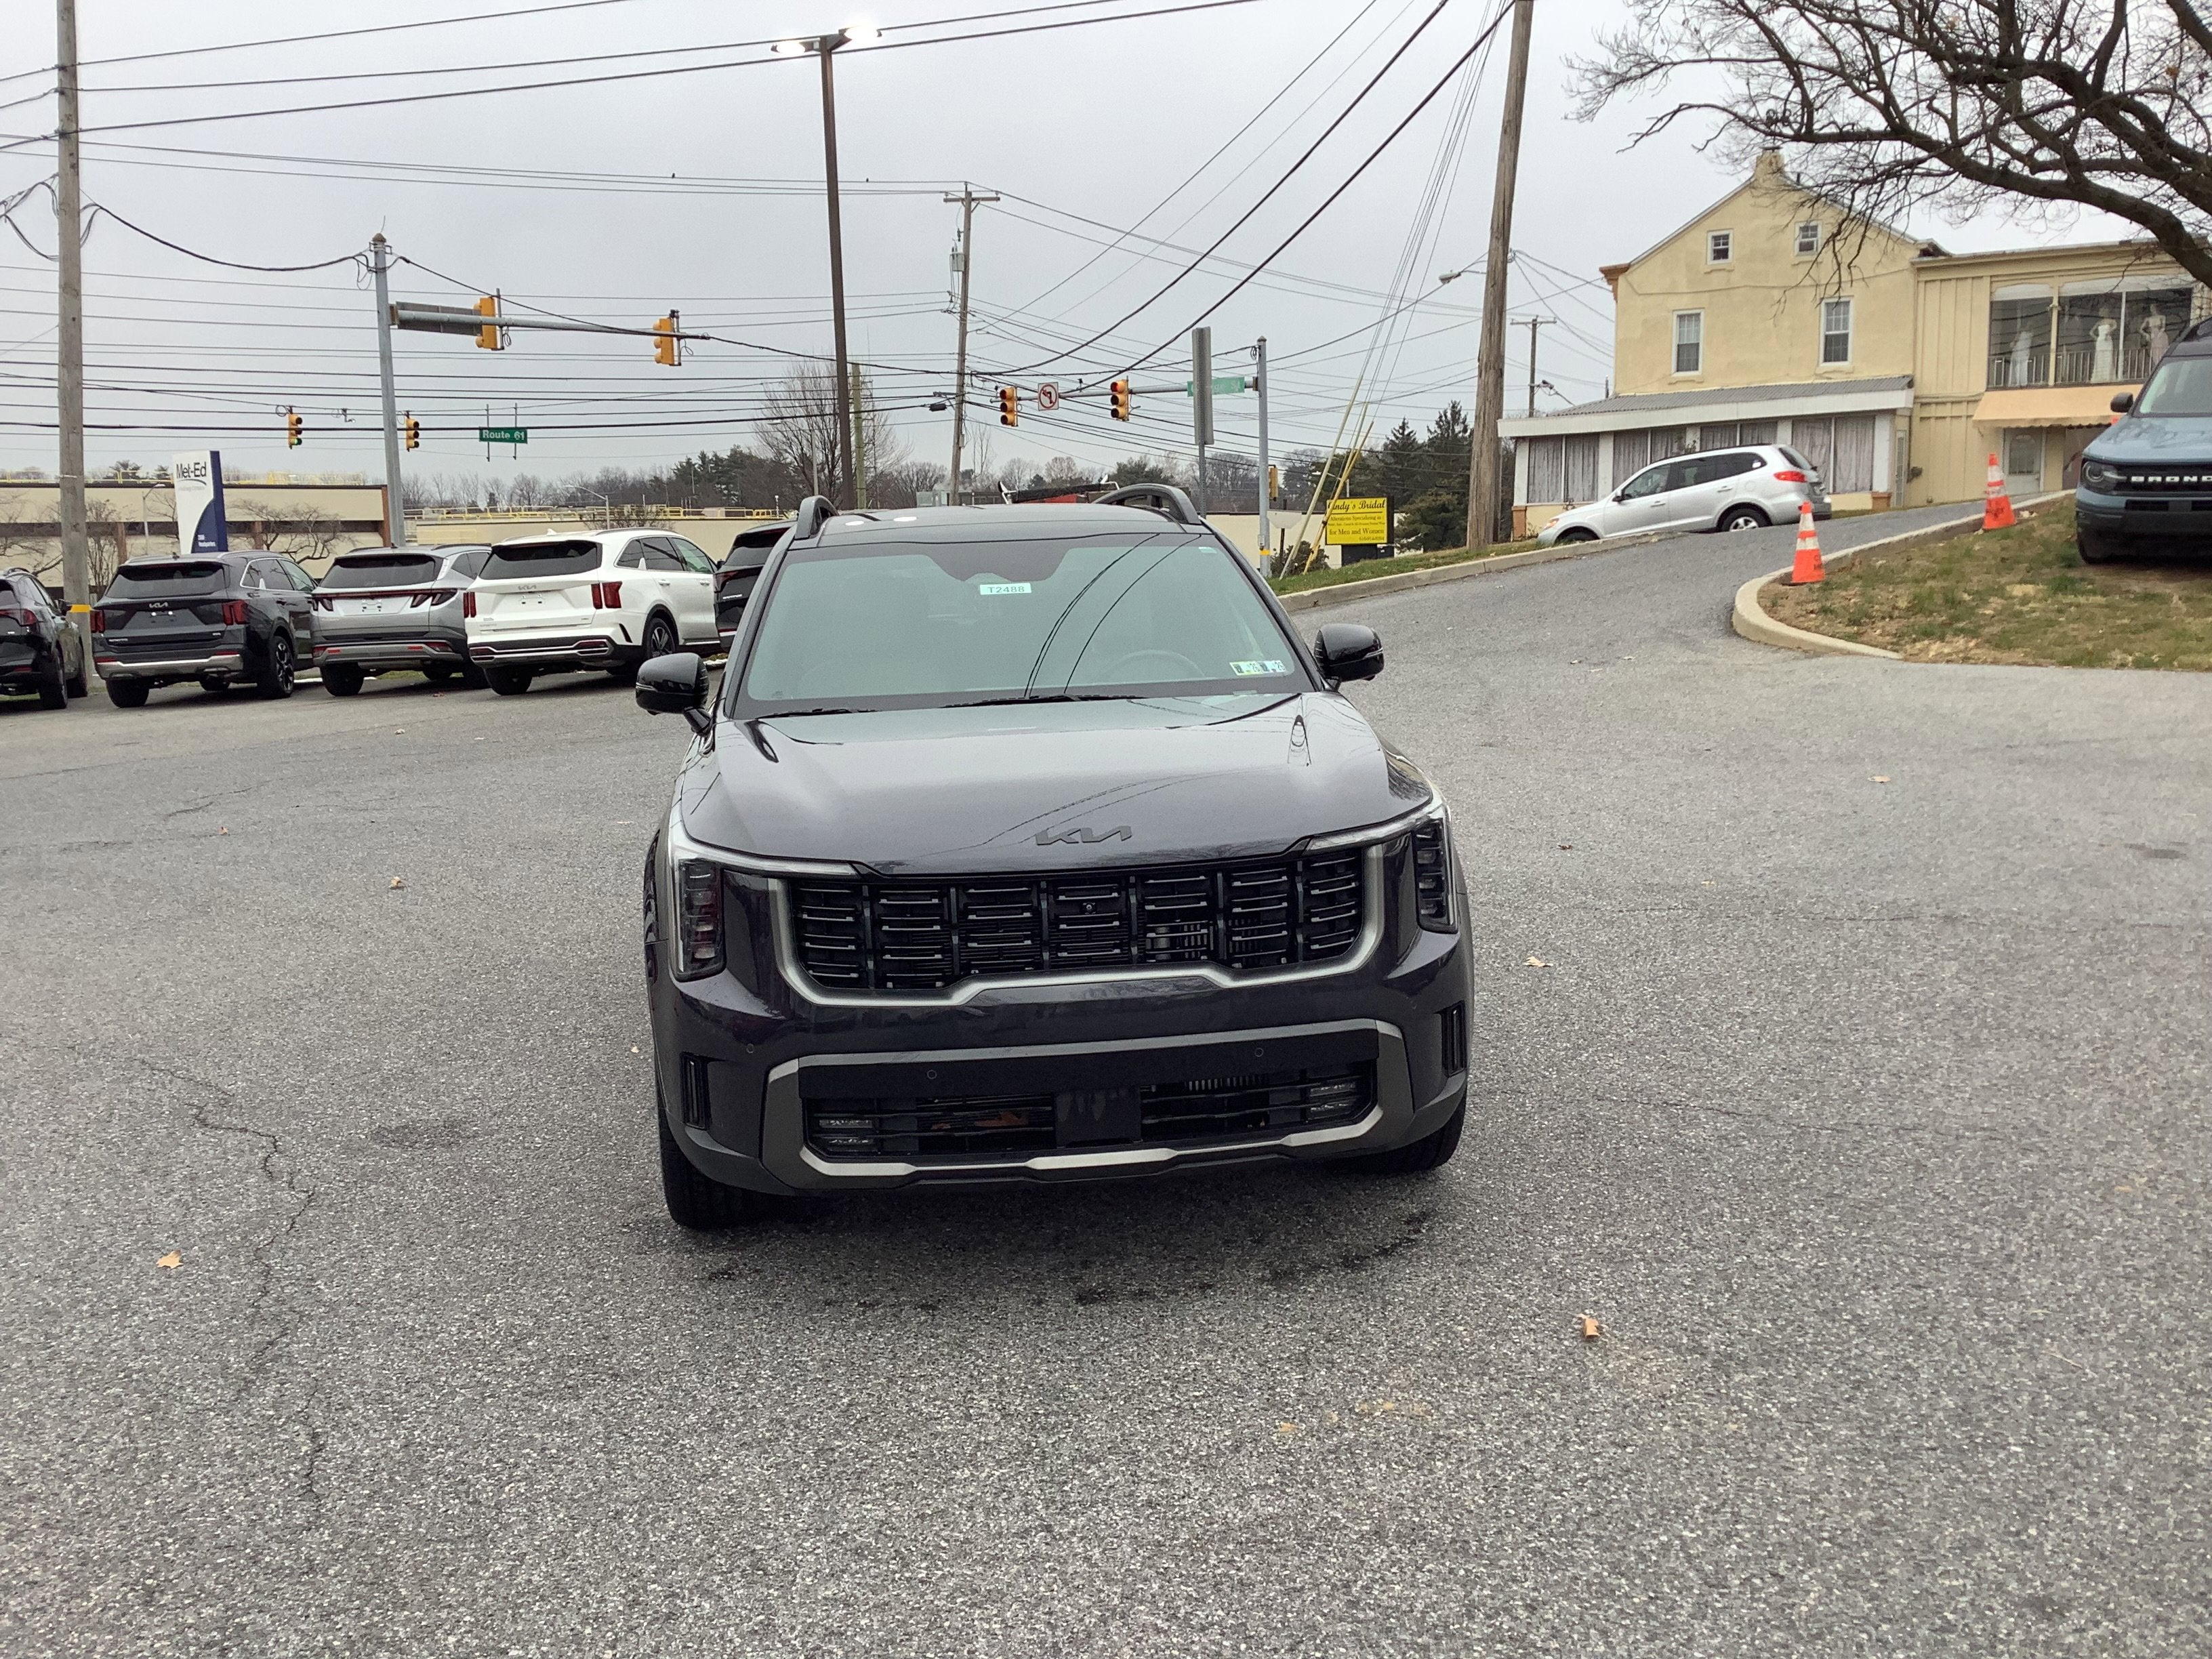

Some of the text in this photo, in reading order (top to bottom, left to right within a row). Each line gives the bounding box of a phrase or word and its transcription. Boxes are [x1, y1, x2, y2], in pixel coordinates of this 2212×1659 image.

[482, 430, 525, 441] Route 61
[176, 461, 207, 478] Met-Ed
[1358, 499, 1386, 510] Bridal
[1036, 825, 1132, 846] KIA
